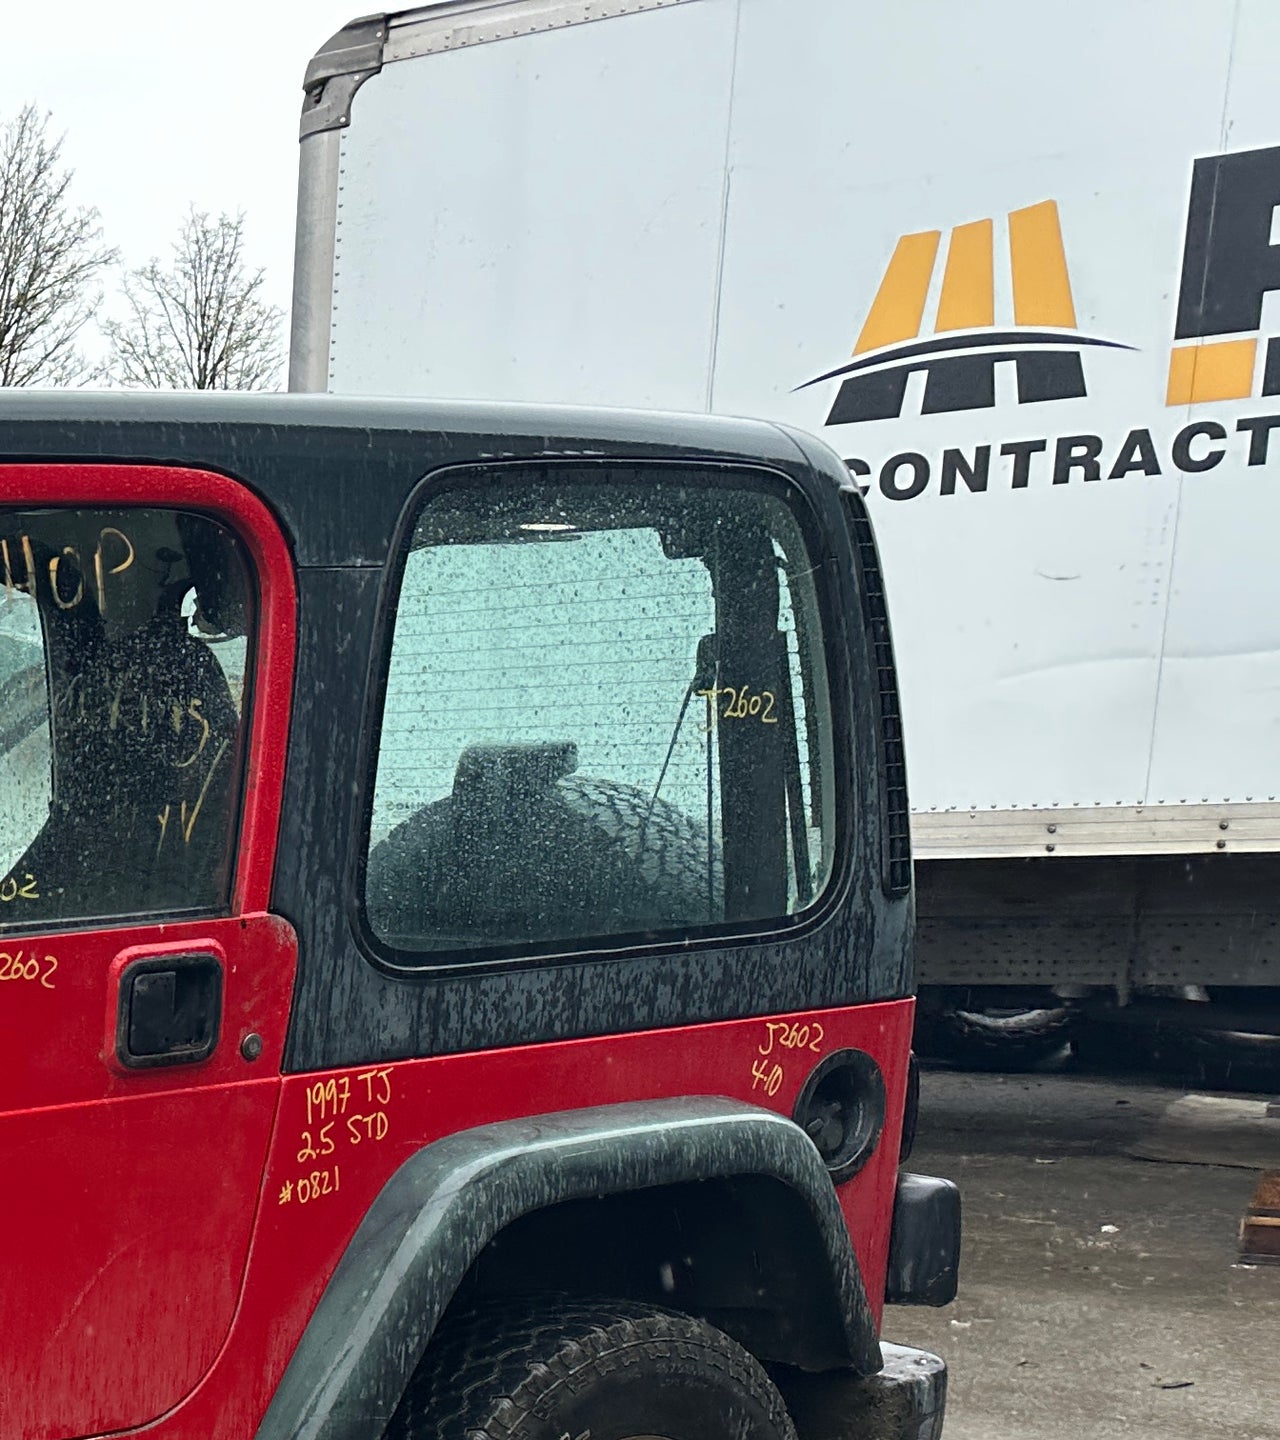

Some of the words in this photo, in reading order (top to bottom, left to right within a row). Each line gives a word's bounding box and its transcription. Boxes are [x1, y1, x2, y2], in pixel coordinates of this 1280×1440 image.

[697, 684, 778, 733] J2602
[759, 1022, 824, 1055] J2602
[306, 1076, 351, 1125] 1997
[358, 1066, 394, 1104] TJ
[297, 1121, 335, 1163] 2.5
[347, 1111, 389, 1144] STD
[278, 1165, 340, 1205] #0821
